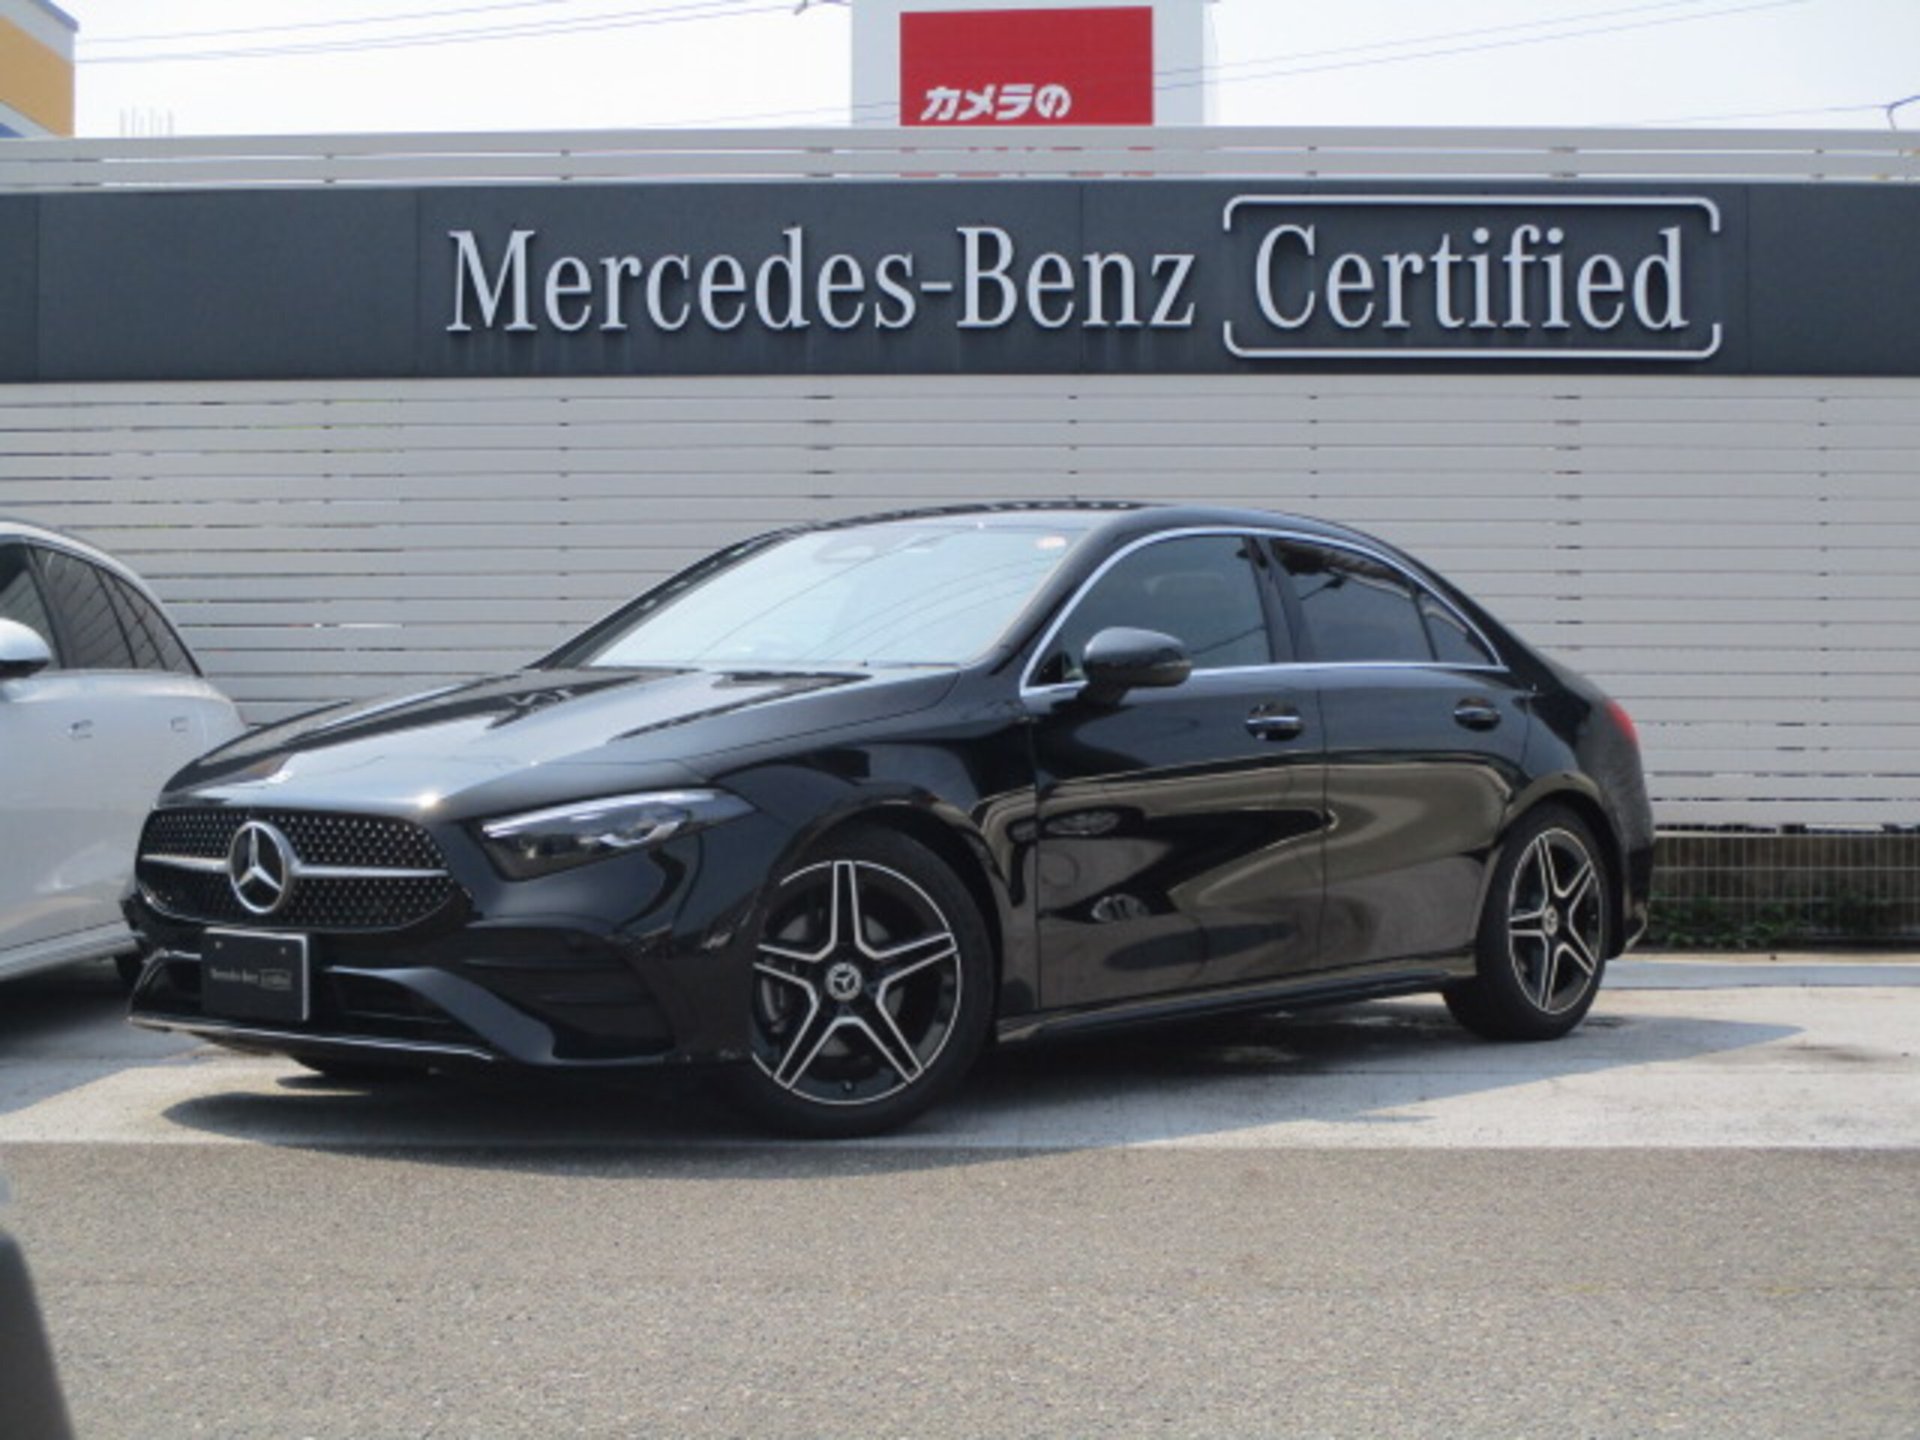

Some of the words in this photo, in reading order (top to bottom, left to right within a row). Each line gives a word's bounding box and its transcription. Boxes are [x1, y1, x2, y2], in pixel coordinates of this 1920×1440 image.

[920, 83, 1072, 121] カメラの
[445, 224, 1196, 332] Mercedes-Benz
[1255, 224, 1690, 330] Certified
